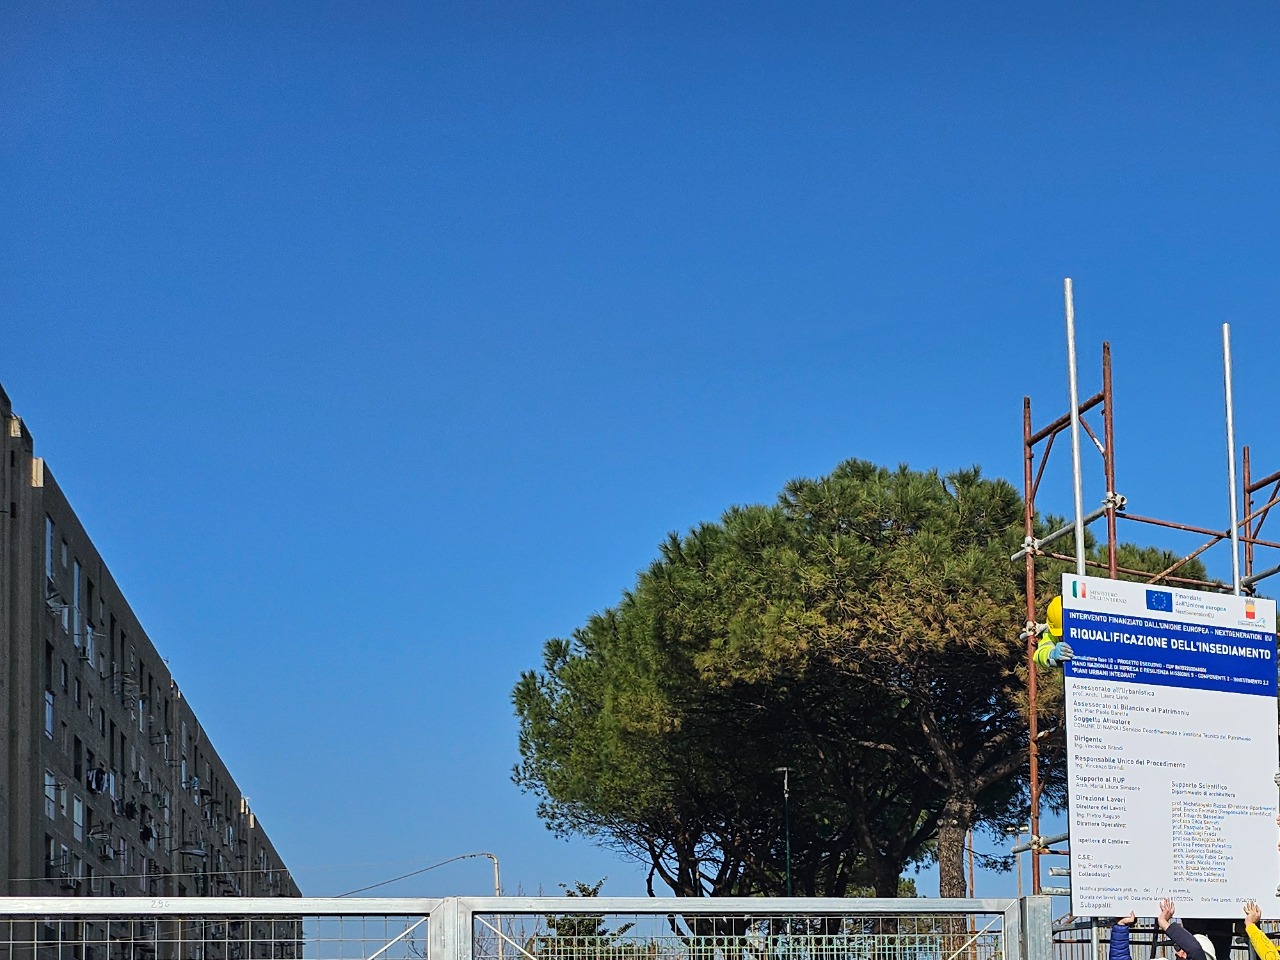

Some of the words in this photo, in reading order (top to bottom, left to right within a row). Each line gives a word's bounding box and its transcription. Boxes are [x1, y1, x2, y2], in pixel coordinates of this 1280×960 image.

[1069, 611, 1107, 622] INTERVENTO
[1108, 616, 1143, 626] FINANZIATO
[1144, 620, 1181, 631] DALL'UNIONE
[1182, 624, 1209, 634] EUROPEA
[1069, 627, 1167, 648] RIQUALIFICAZIONE
[1170, 638, 1270, 659] DELL'INSEDIAMENTO
[1072, 683, 1110, 692] Assessorato
[1073, 699, 1111, 709] Assessorato
[1073, 714, 1100, 724] Soggetto
[1074, 734, 1102, 743] Dirigente
[1074, 754, 1115, 764] Responsabile
[1146, 759, 1185, 768] Procedimento
[1075, 774, 1103, 783] Supporto
[1171, 780, 1197, 788] Supporto
[1198, 782, 1227, 790] Scientifico
[1075, 794, 1104, 802] Direzione
[1106, 795, 1125, 803] Lavori
